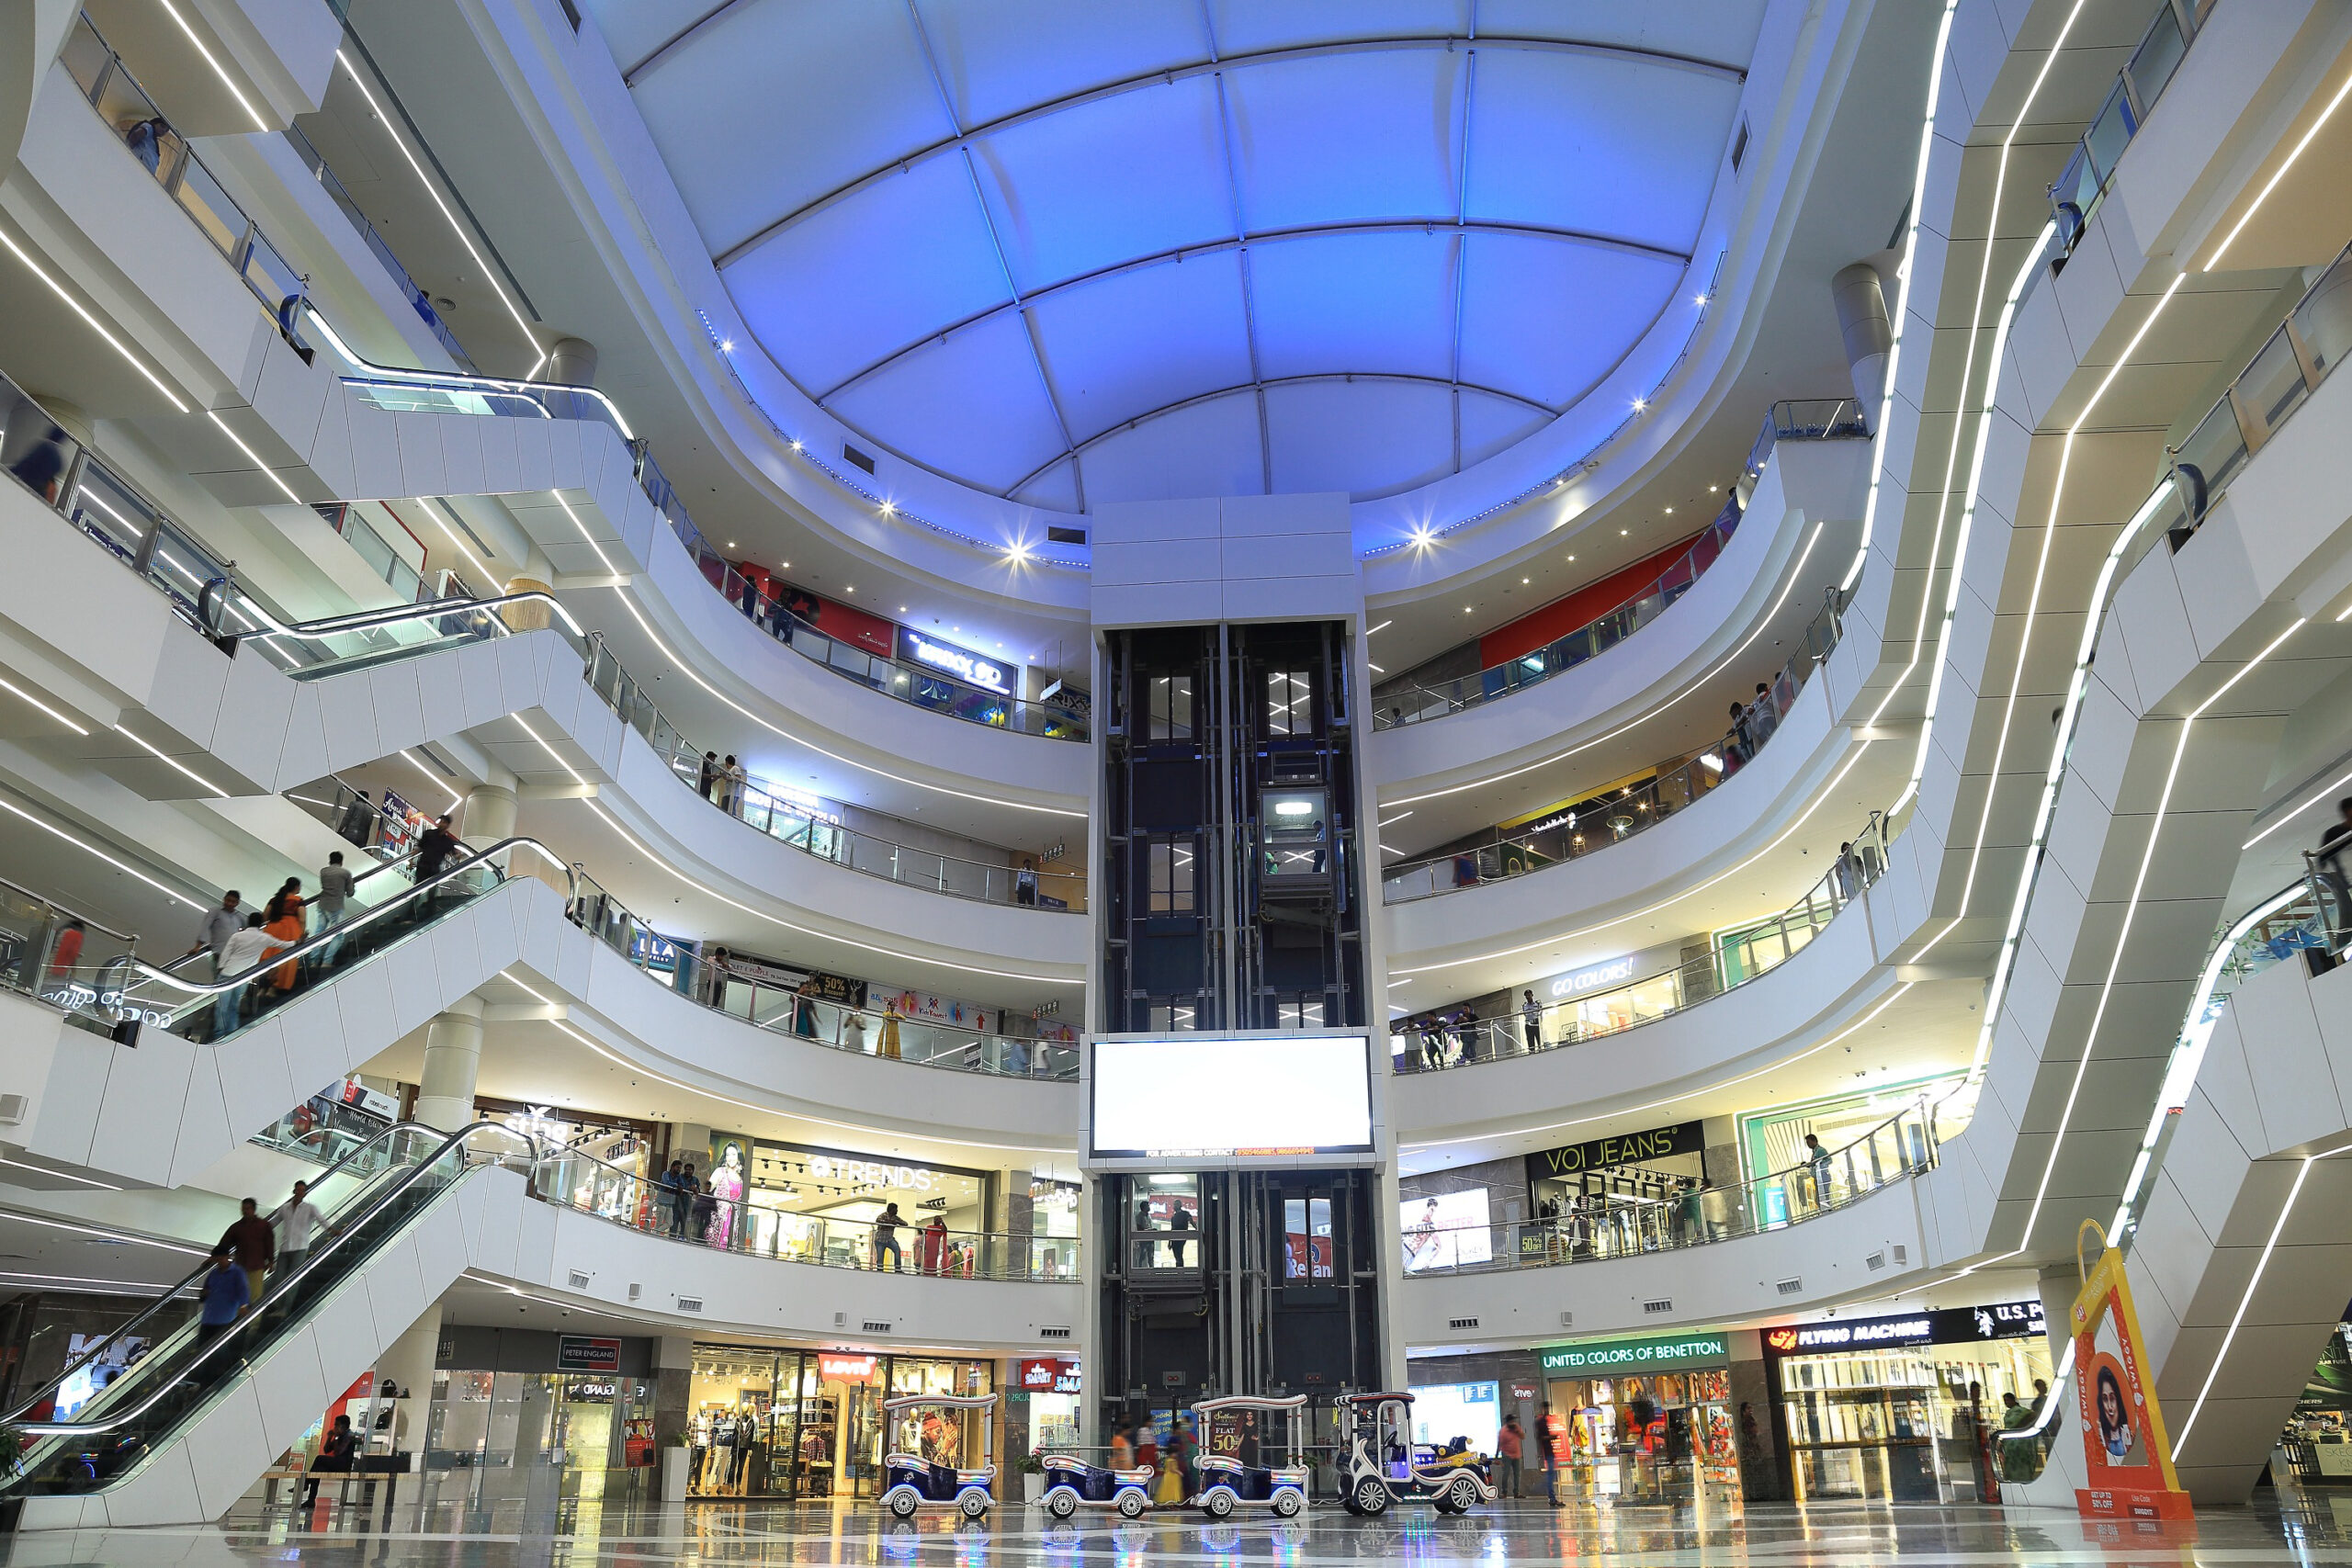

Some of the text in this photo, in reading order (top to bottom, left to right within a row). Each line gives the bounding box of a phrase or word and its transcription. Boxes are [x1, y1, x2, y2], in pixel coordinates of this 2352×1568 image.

[825, 976, 845, 992] 50%
[1552, 956, 1634, 997] GO COLORS!
[1146, 1150, 1159, 1158] FOR
[1546, 1129, 1673, 1173] VOI JEANS
[829, 1156, 933, 1191] TRENDS
[1798, 1320, 1931, 1347] FLYING MACHINE
[565, 1348, 615, 1359] PETER ENGLAND
[1543, 1340, 1725, 1369] UNITED COLORS OF BENETTON.
[2121, 1337, 2140, 1391] SWIGGY
[1024, 1371, 1053, 1385] SMART
[1054, 1375, 1081, 1393] SMA
[2077, 1367, 2089, 1418] SWIGGY
[1216, 1427, 1236, 1435] FLAT
[2324, 1447, 2352, 1458] SKEC
[2090, 1491, 2099, 1499] GET
[2132, 1495, 2151, 1503] Use Code
[2091, 1499, 2114, 1509] 50% OFF
